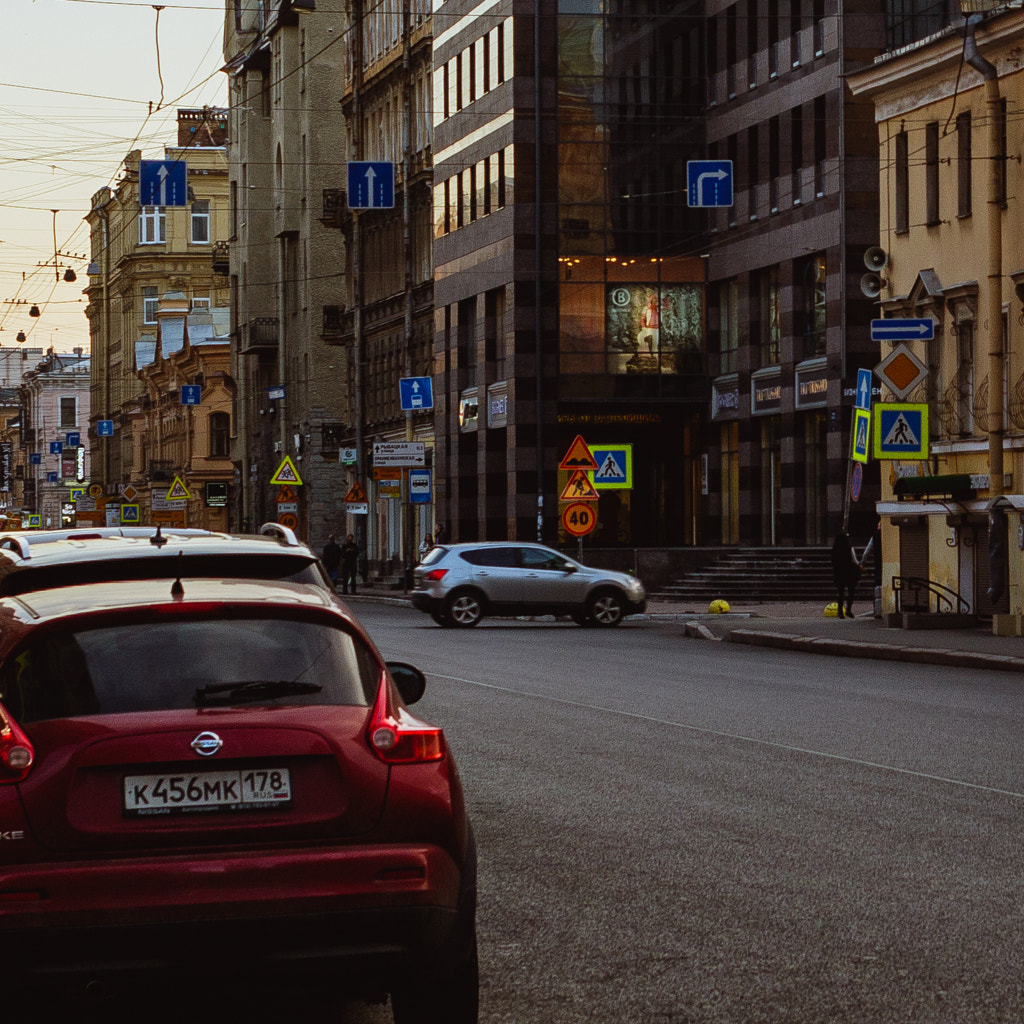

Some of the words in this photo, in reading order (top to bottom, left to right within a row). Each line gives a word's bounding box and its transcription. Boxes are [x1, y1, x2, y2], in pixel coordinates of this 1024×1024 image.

[569, 511, 589, 526] 40
[243, 771, 283, 791] 178
[252, 790, 273, 799] RUS
[137, 807, 171, 816] NISSAN
